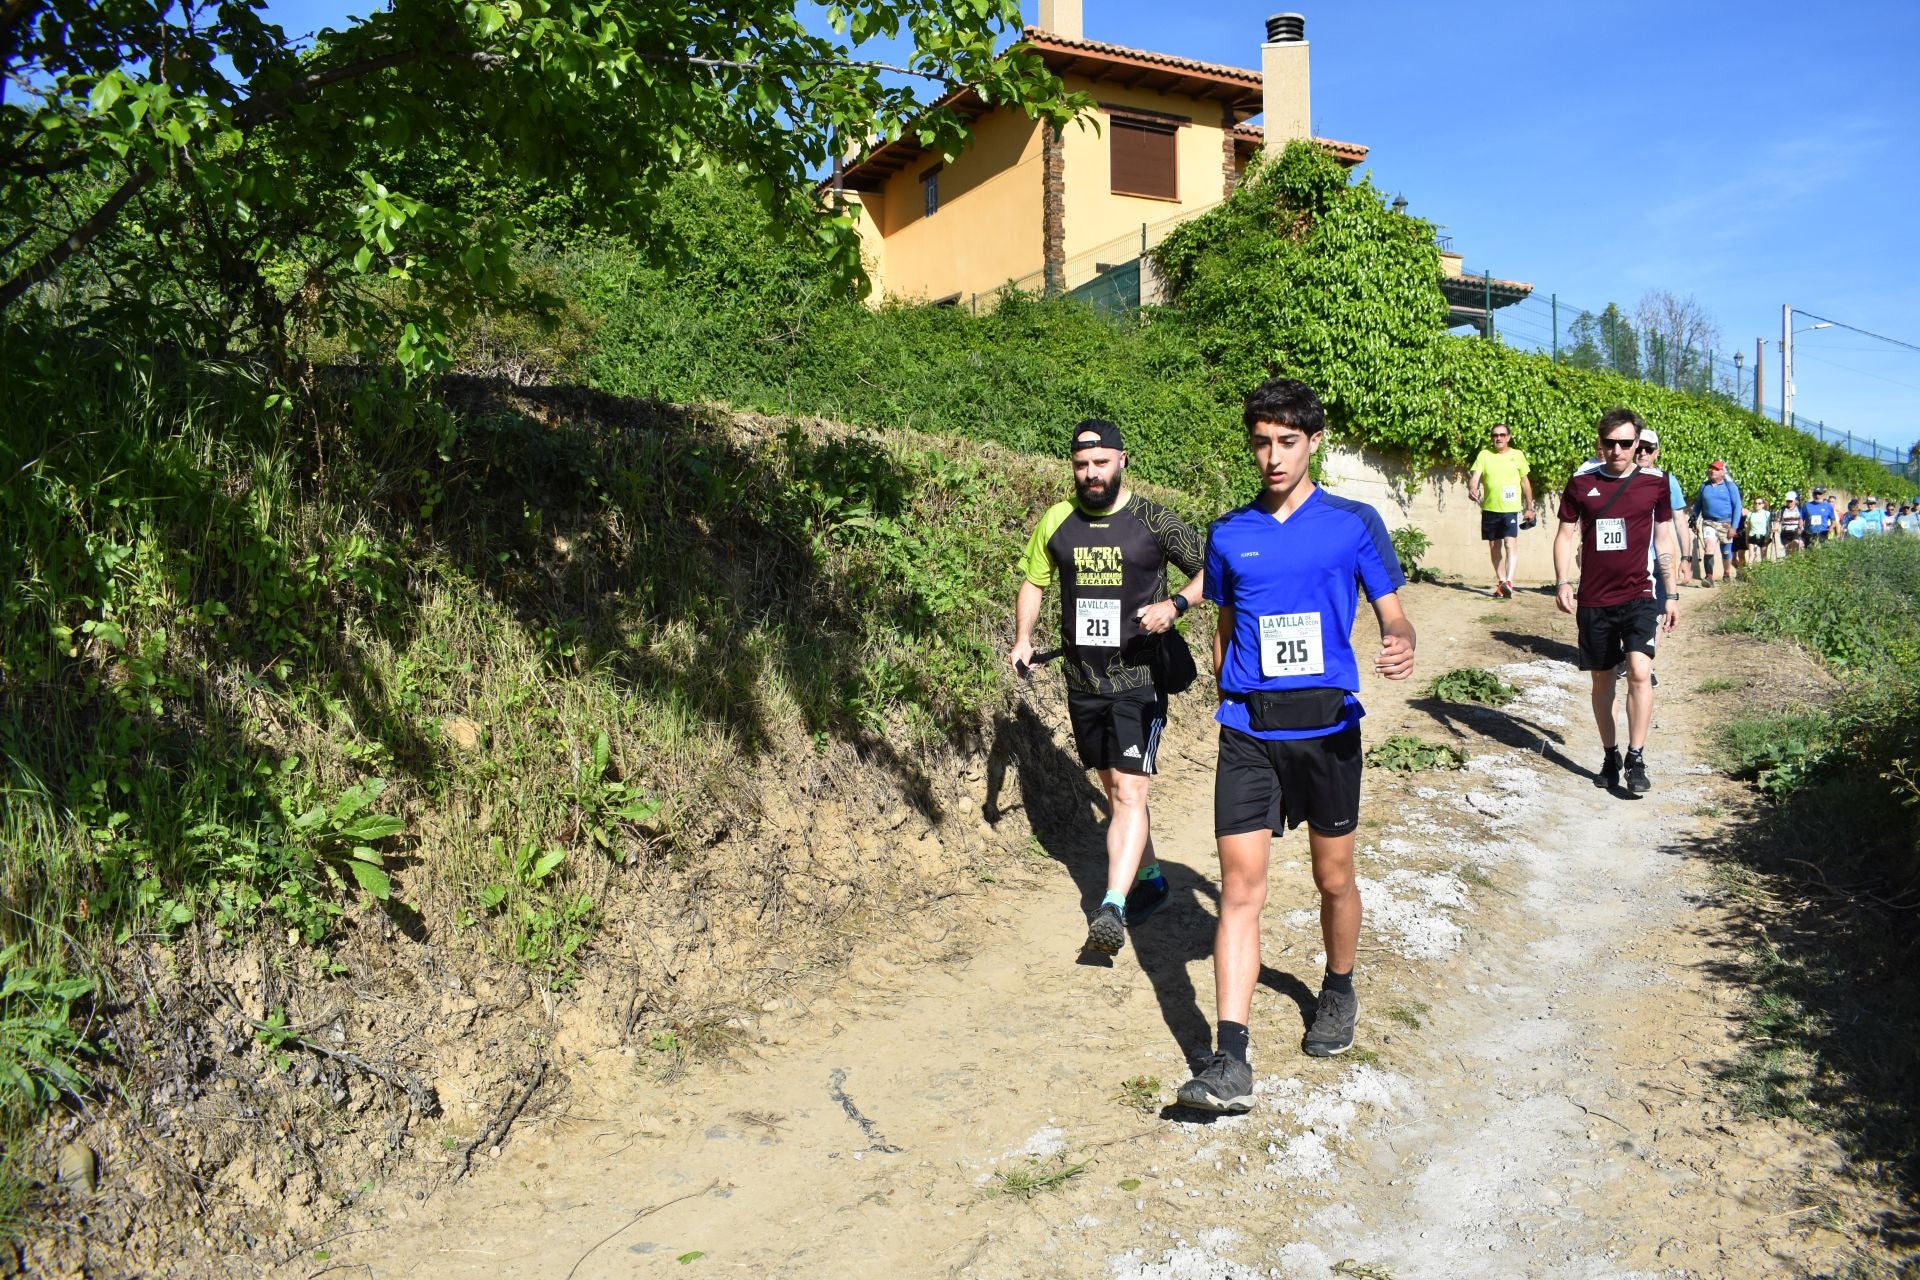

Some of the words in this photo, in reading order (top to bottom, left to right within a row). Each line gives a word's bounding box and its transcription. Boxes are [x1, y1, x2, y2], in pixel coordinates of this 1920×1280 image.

[1604, 532, 1621, 544] 210
[1073, 547, 1122, 559] ULTRA
[1079, 600, 1087, 608] LA
[1088, 600, 1108, 609] VILLA
[1086, 619, 1109, 636] 213
[1262, 618, 1274, 628] LA
[1275, 615, 1304, 627] VILLA
[1276, 639, 1308, 664] 215
